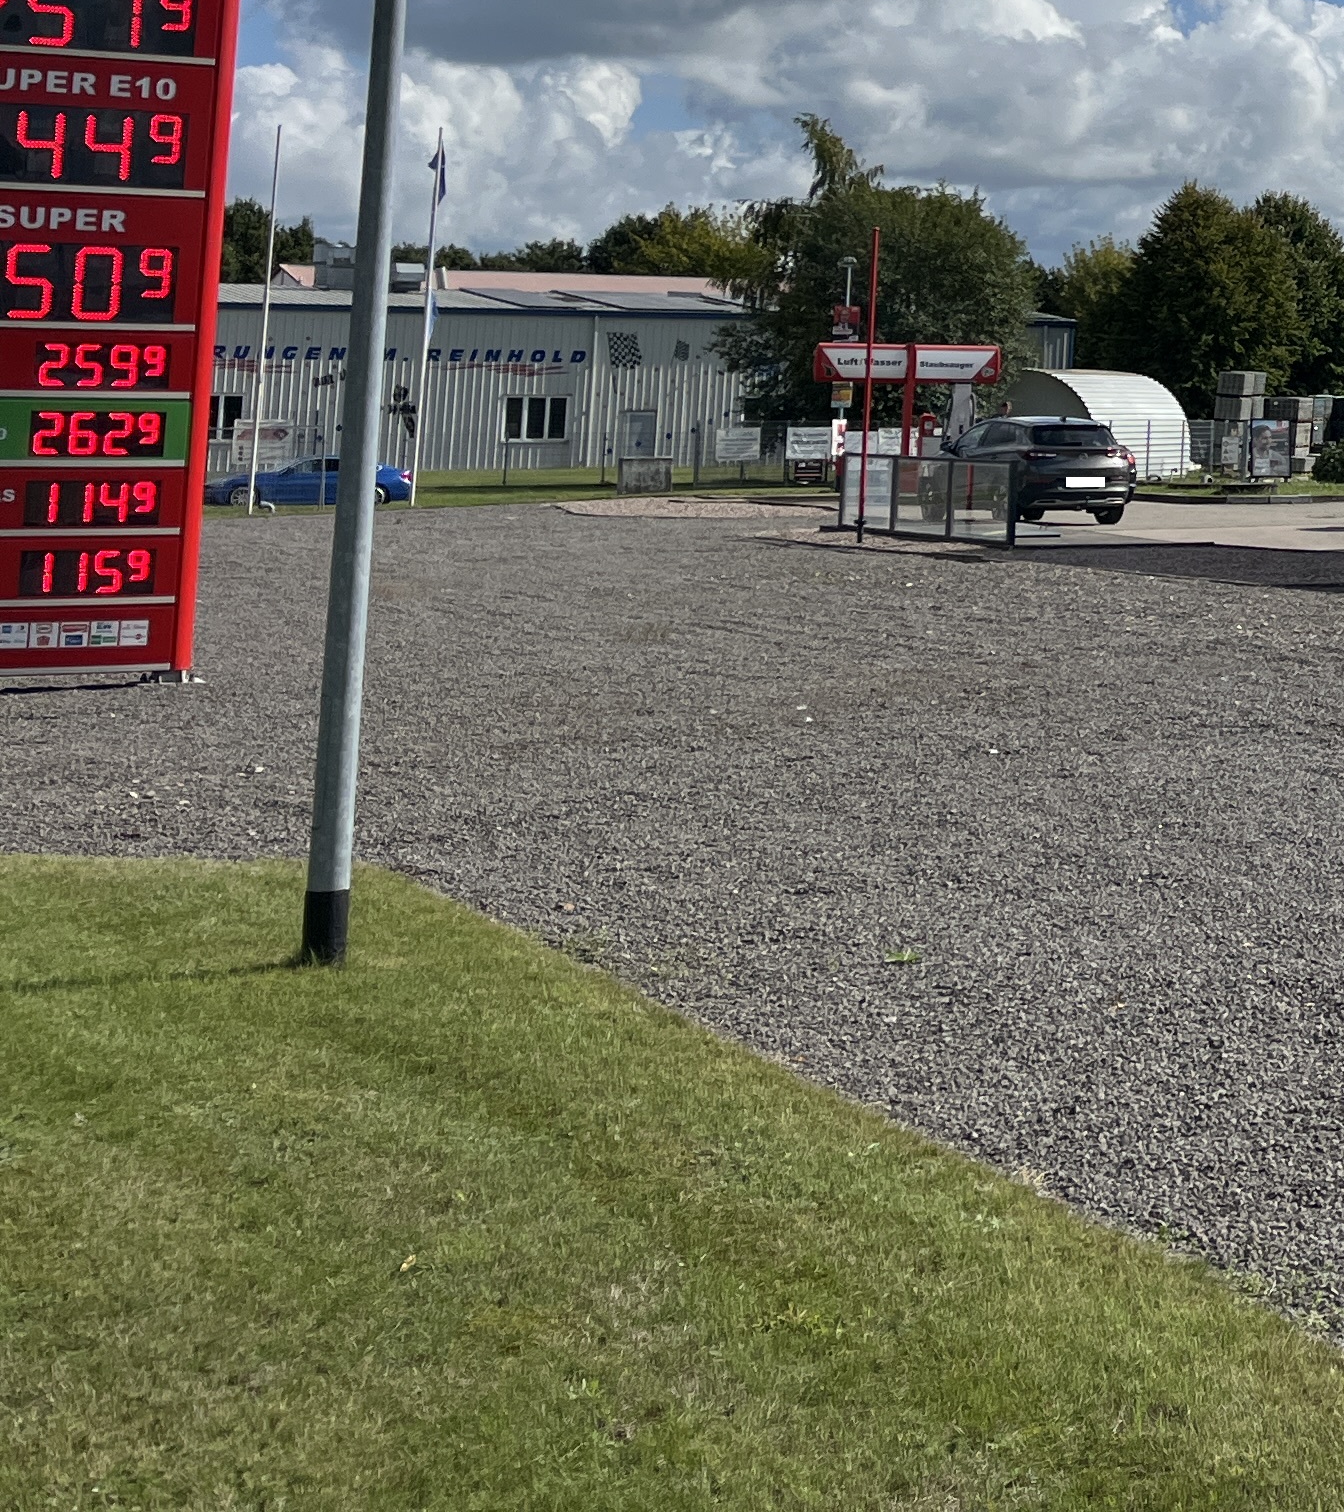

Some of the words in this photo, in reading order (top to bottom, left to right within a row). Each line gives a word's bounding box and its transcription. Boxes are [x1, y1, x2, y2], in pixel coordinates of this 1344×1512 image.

[109, 75, 177, 100] E10
[16, 110, 183, 181] 449
[0, 205, 126, 233] SUPER
[5, 244, 173, 320] 509
[38, 343, 167, 387] 2599
[427, 349, 588, 364] REINHOLD
[32, 412, 161, 456] 2629
[46, 481, 157, 523] 1149
[42, 549, 151, 594] 1159
